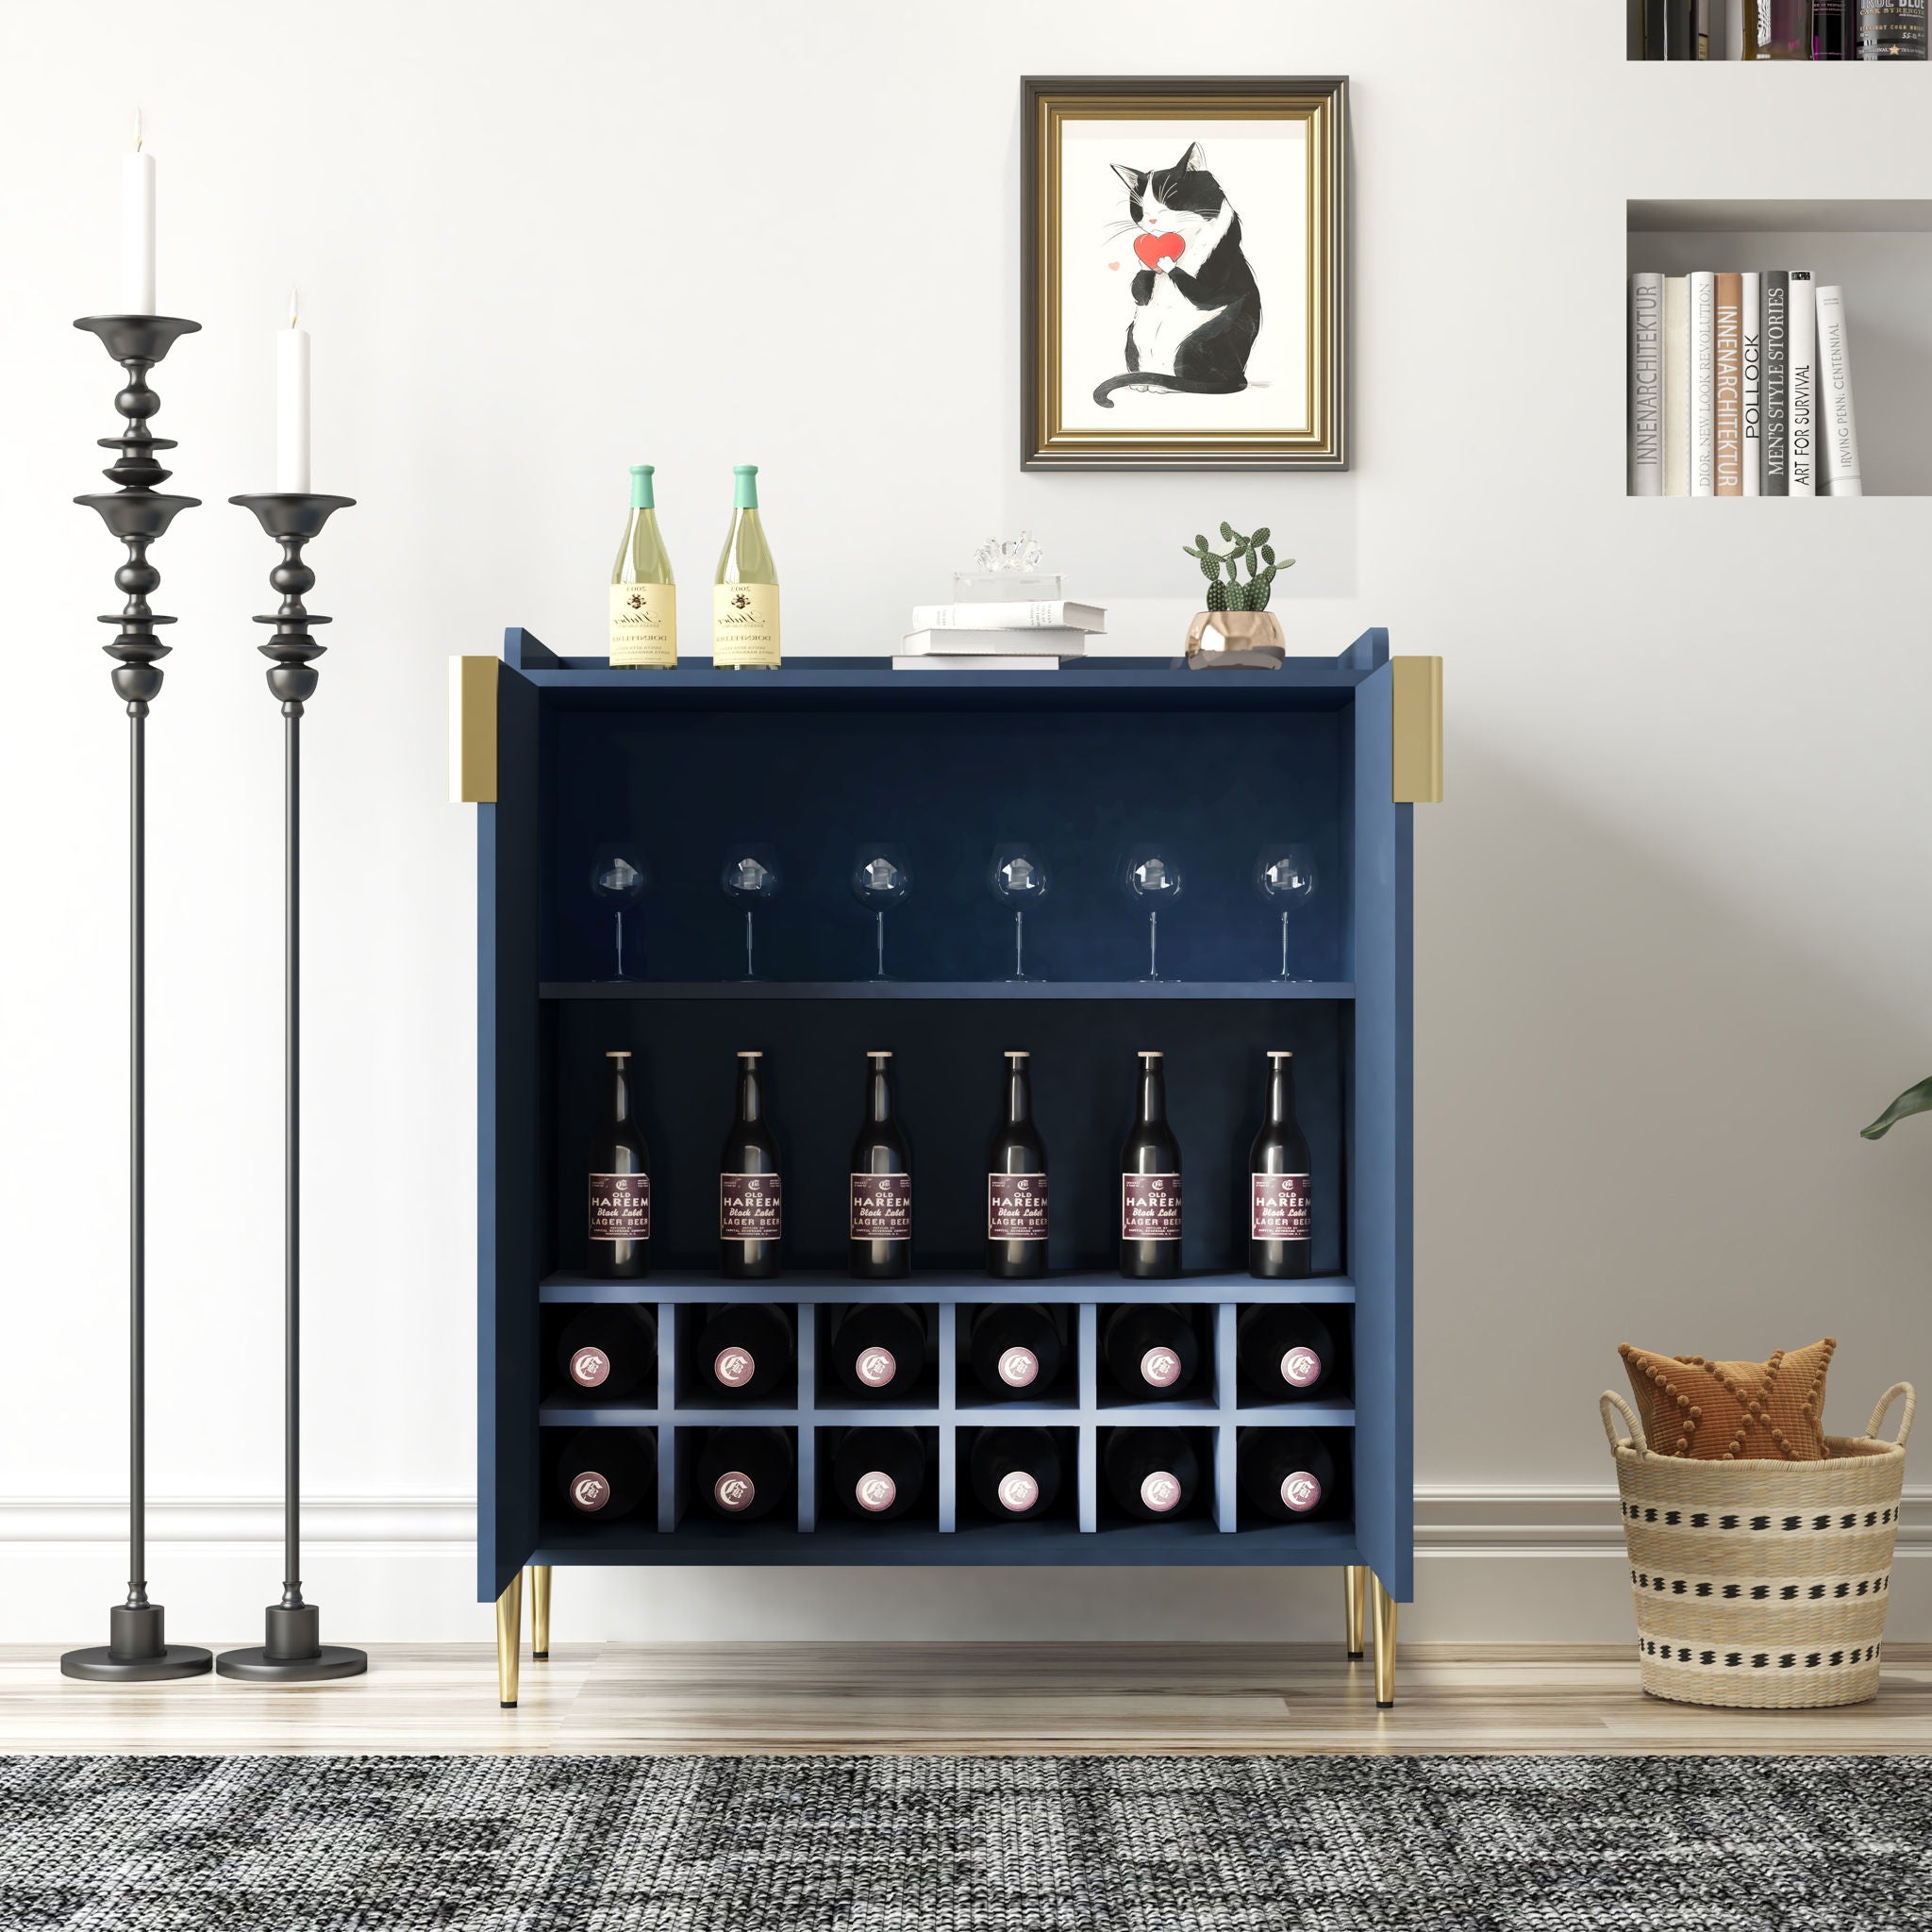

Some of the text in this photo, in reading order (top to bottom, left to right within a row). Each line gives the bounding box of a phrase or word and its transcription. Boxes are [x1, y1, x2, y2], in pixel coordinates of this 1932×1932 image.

[1828, 323, 1844, 390] CENTENNIAL
[1637, 286, 1657, 465] INNENARCHITEKTUR
[1699, 283, 1710, 487] DIOR. NEW LOOK REVOLUTION
[1744, 334, 1759, 439] POLLOCK
[1768, 288, 1784, 475] MEN'S STYLE STORIES
[1717, 306, 1738, 487] INNENARCHITEKTUR
[1794, 365, 1809, 486] ART FOR SURVIVAL
[1838, 427, 1852, 468] IRVING
[591, 1197, 648, 1207] HAREEM
[724, 1197, 780, 1207] HAREEM
[854, 1197, 910, 1207] HAREEM
[992, 1197, 1047, 1207] HAREEM
[597, 1208, 619, 1217] Black
[729, 1208, 774, 1217] Black Label
[859, 1208, 881, 1217] Black
[998, 1208, 1042, 1217] Black Label
[1132, 1208, 1155, 1217] Black
[1262, 1208, 1285, 1217] Black
